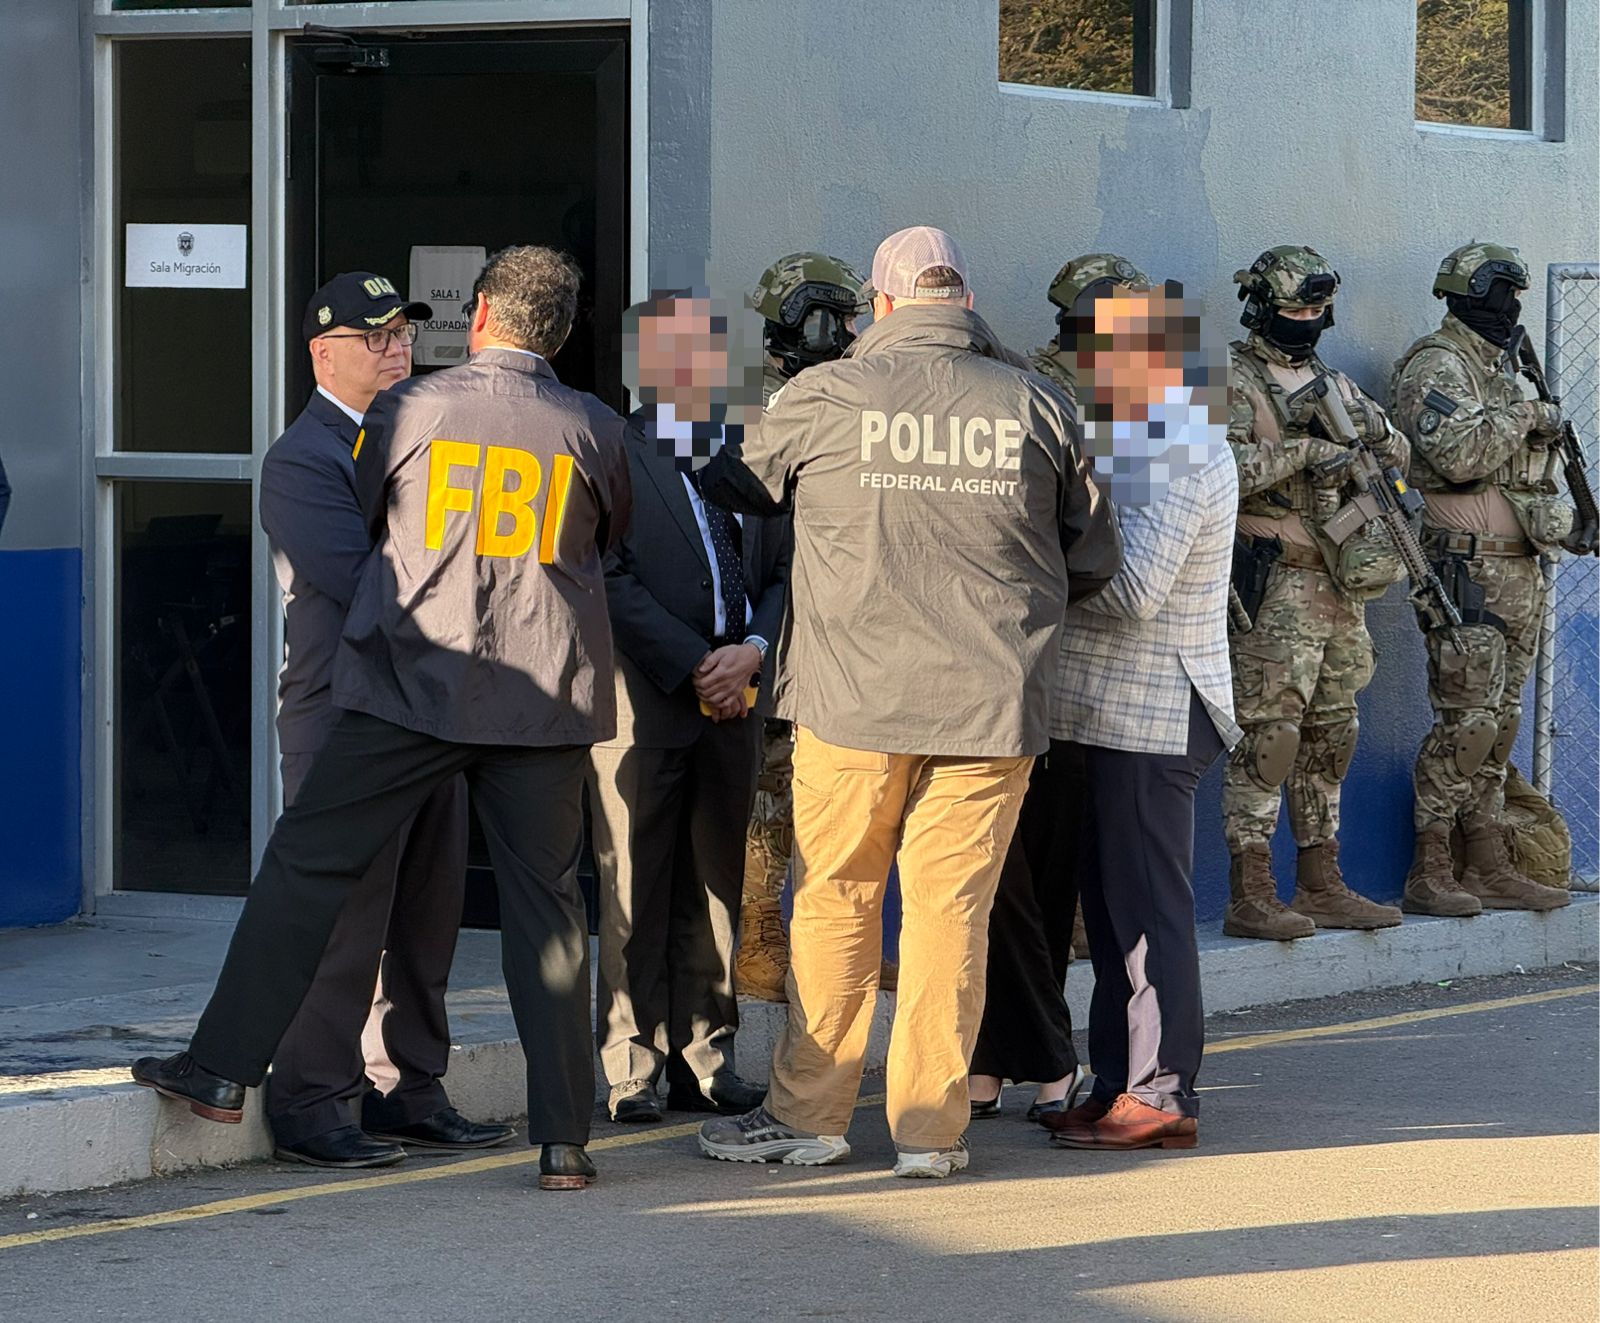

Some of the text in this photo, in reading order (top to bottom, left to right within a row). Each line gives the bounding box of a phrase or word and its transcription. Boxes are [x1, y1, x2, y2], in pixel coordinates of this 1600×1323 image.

[150, 261, 221, 276] Sala Migración
[430, 289, 460, 299] SALA 1
[423, 320, 468, 330] OCUPADA
[860, 410, 1021, 470] POLICE
[859, 472, 1018, 496] FEDERAL AGENT
[425, 439, 574, 565] FBI
